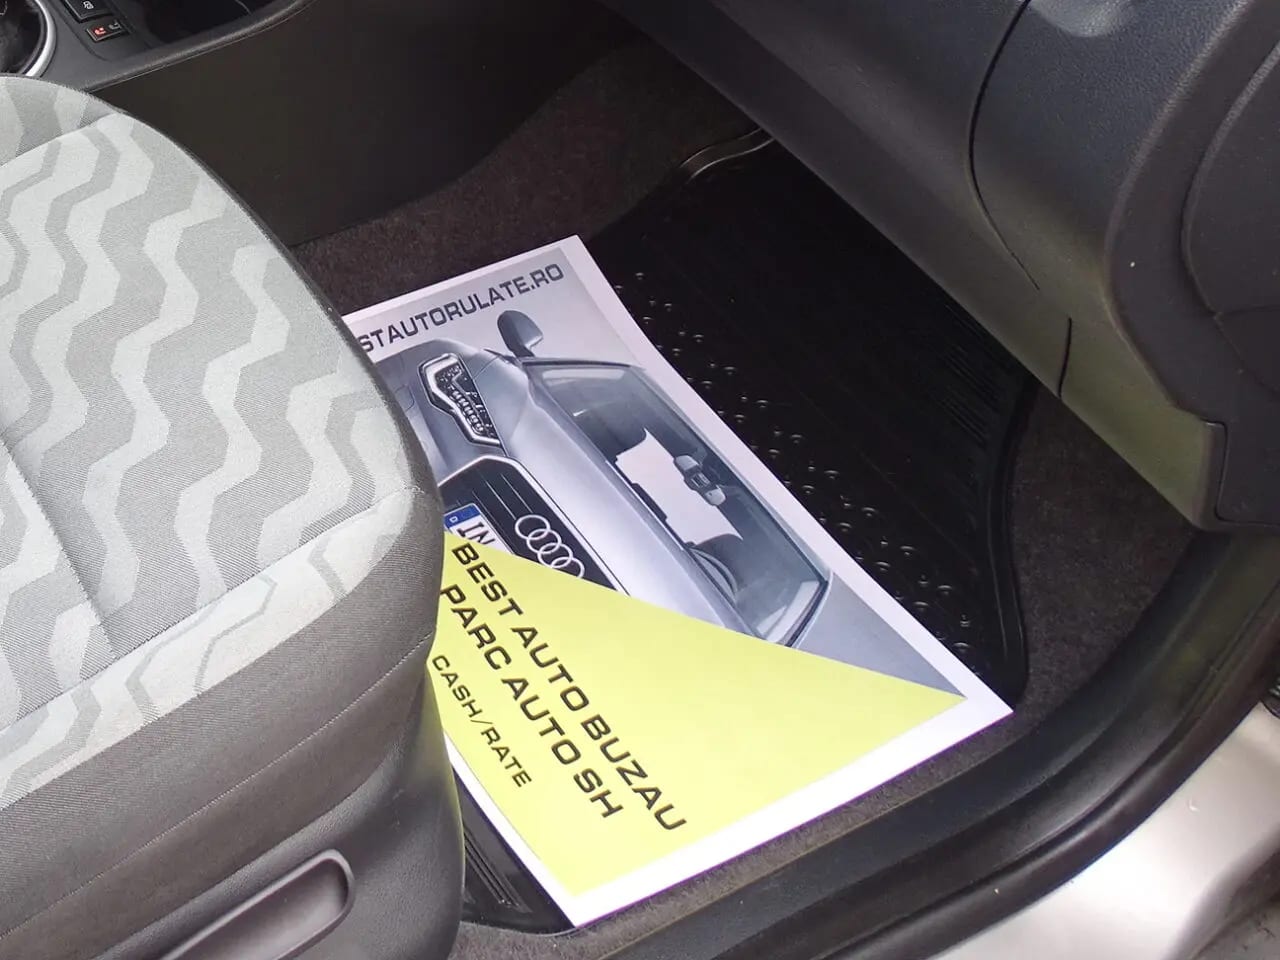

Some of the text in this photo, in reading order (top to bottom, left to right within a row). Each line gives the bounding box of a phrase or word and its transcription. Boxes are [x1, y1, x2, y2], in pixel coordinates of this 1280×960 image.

[456, 521, 496, 545] IN
[431, 654, 533, 788] CASH/RATE
[440, 583, 624, 819] PARC AUTO SH
[452, 542, 687, 831] BEST AUTO BUZAU
